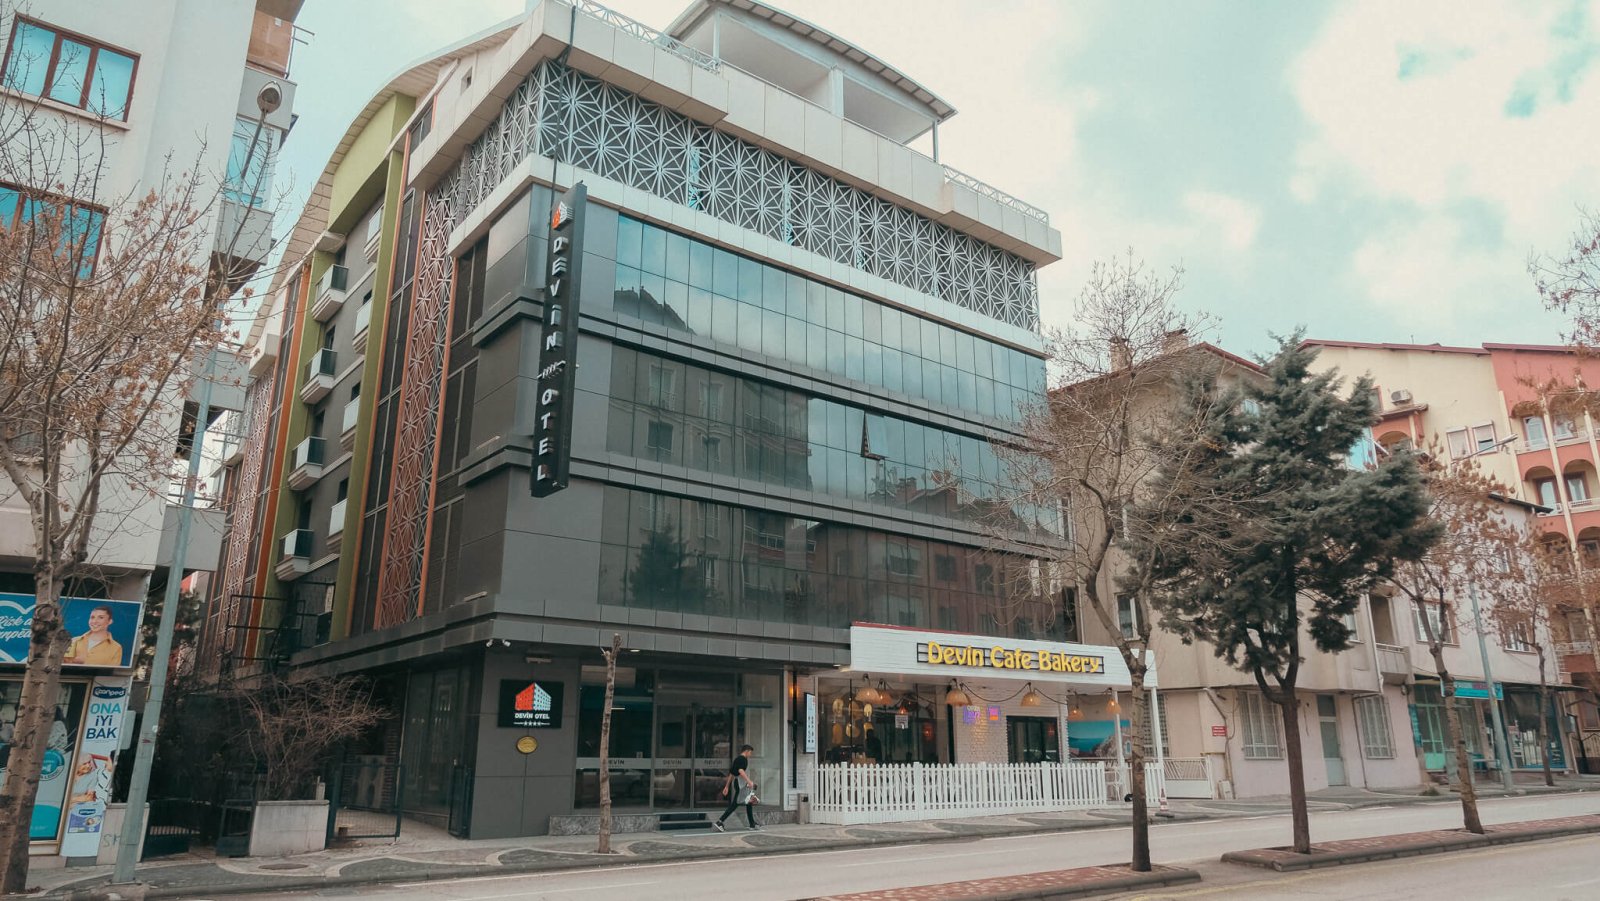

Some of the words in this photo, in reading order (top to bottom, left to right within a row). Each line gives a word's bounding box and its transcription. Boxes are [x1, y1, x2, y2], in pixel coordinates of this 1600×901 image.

[537, 388, 557, 481] OTEL
[927, 641, 984, 666] Devin
[990, 646, 1032, 669] Cafe
[1038, 650, 1100, 673] Bakery
[90, 702, 122, 714] ONA
[86, 727, 117, 739] BAK
